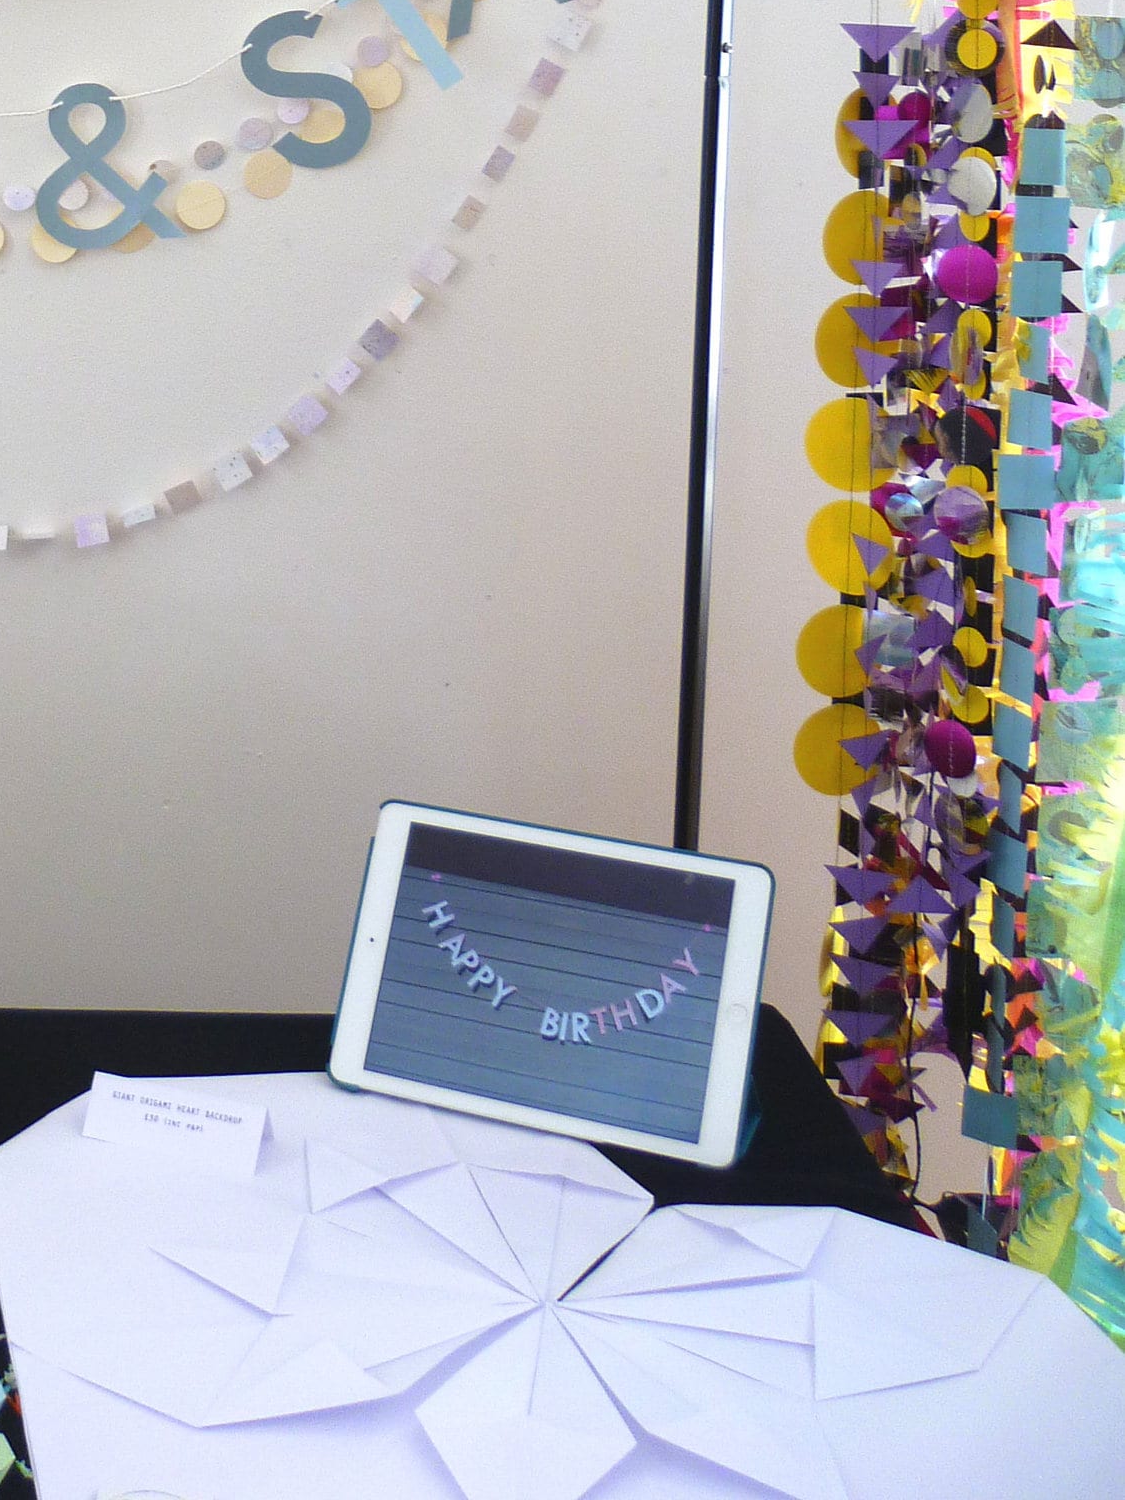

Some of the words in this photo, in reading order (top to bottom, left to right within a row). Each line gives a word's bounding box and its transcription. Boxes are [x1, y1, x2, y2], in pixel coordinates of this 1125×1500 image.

[35, 83, 185, 251] &
[422, 900, 518, 1009] HAPPY
[539, 947, 701, 1045] BIRTHDAY
[113, 1090, 135, 1102] GIANT
[139, 1095, 172, 1110] ORIGAMI
[176, 1103, 200, 1117] HEART
[205, 1110, 243, 1125] BACKDROP
